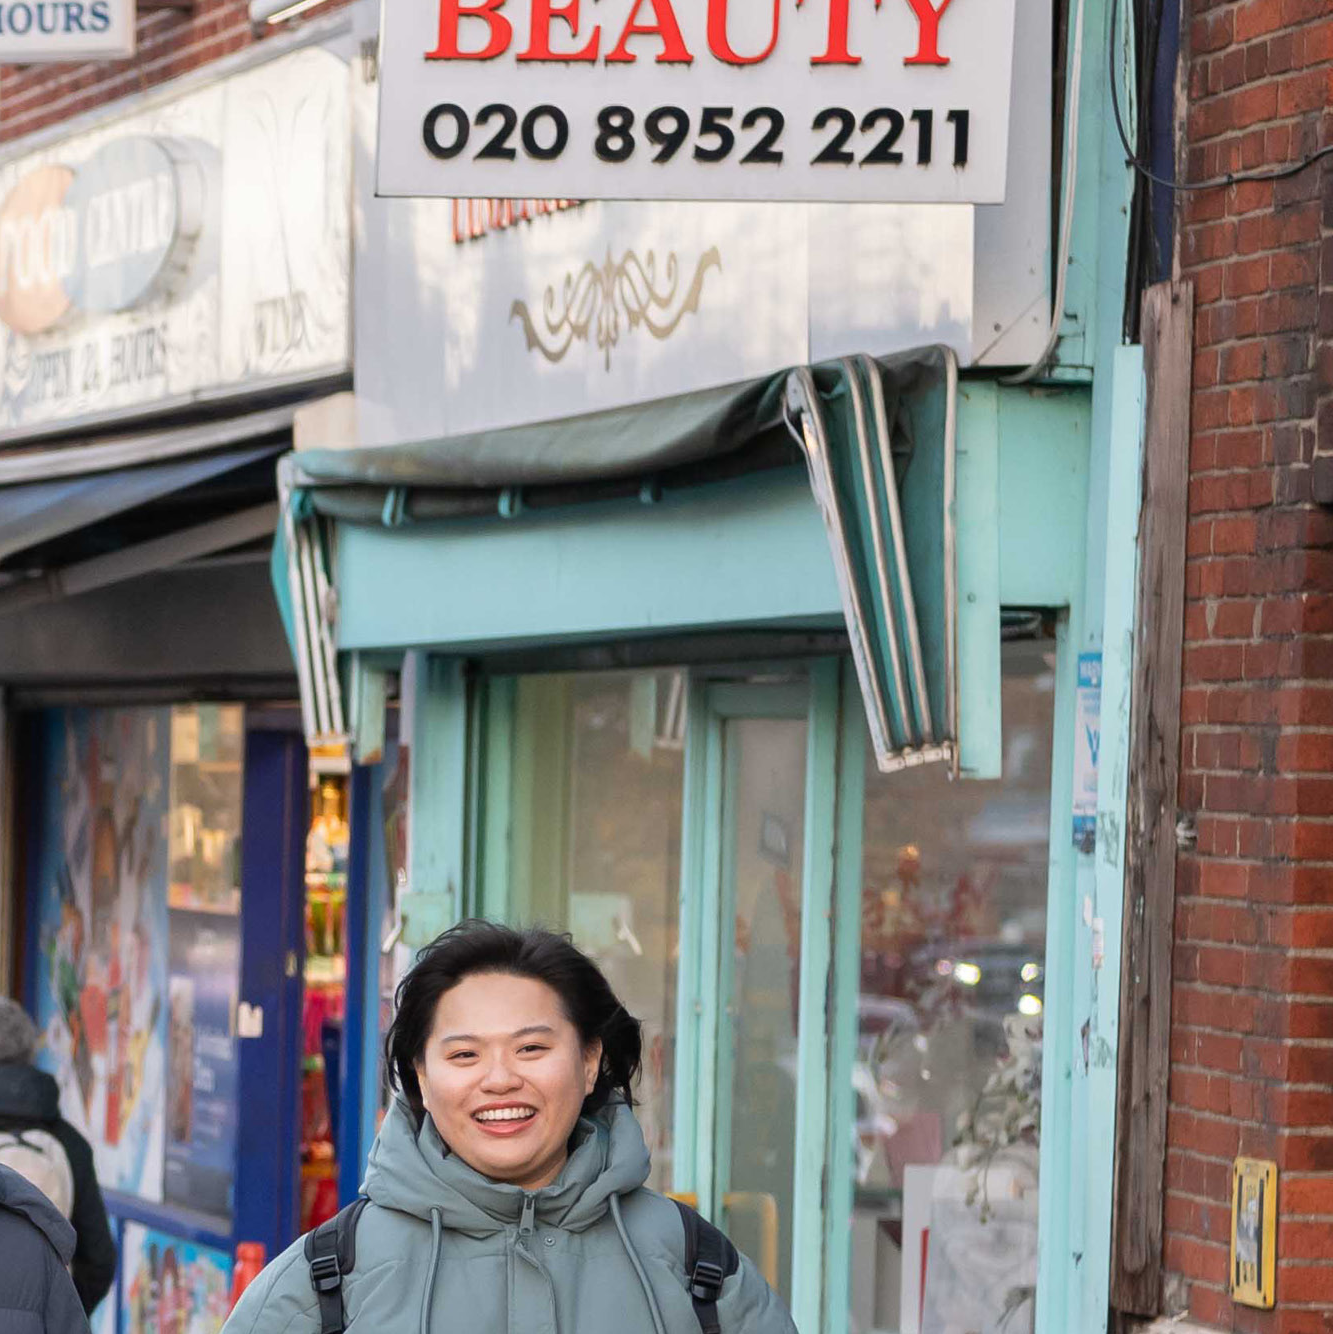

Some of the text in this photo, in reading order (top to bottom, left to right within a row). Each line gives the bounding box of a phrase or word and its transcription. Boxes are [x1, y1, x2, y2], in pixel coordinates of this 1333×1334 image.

[424, 0, 950, 65] BEAUTY
[422, 103, 971, 168] 020 8952 2211
